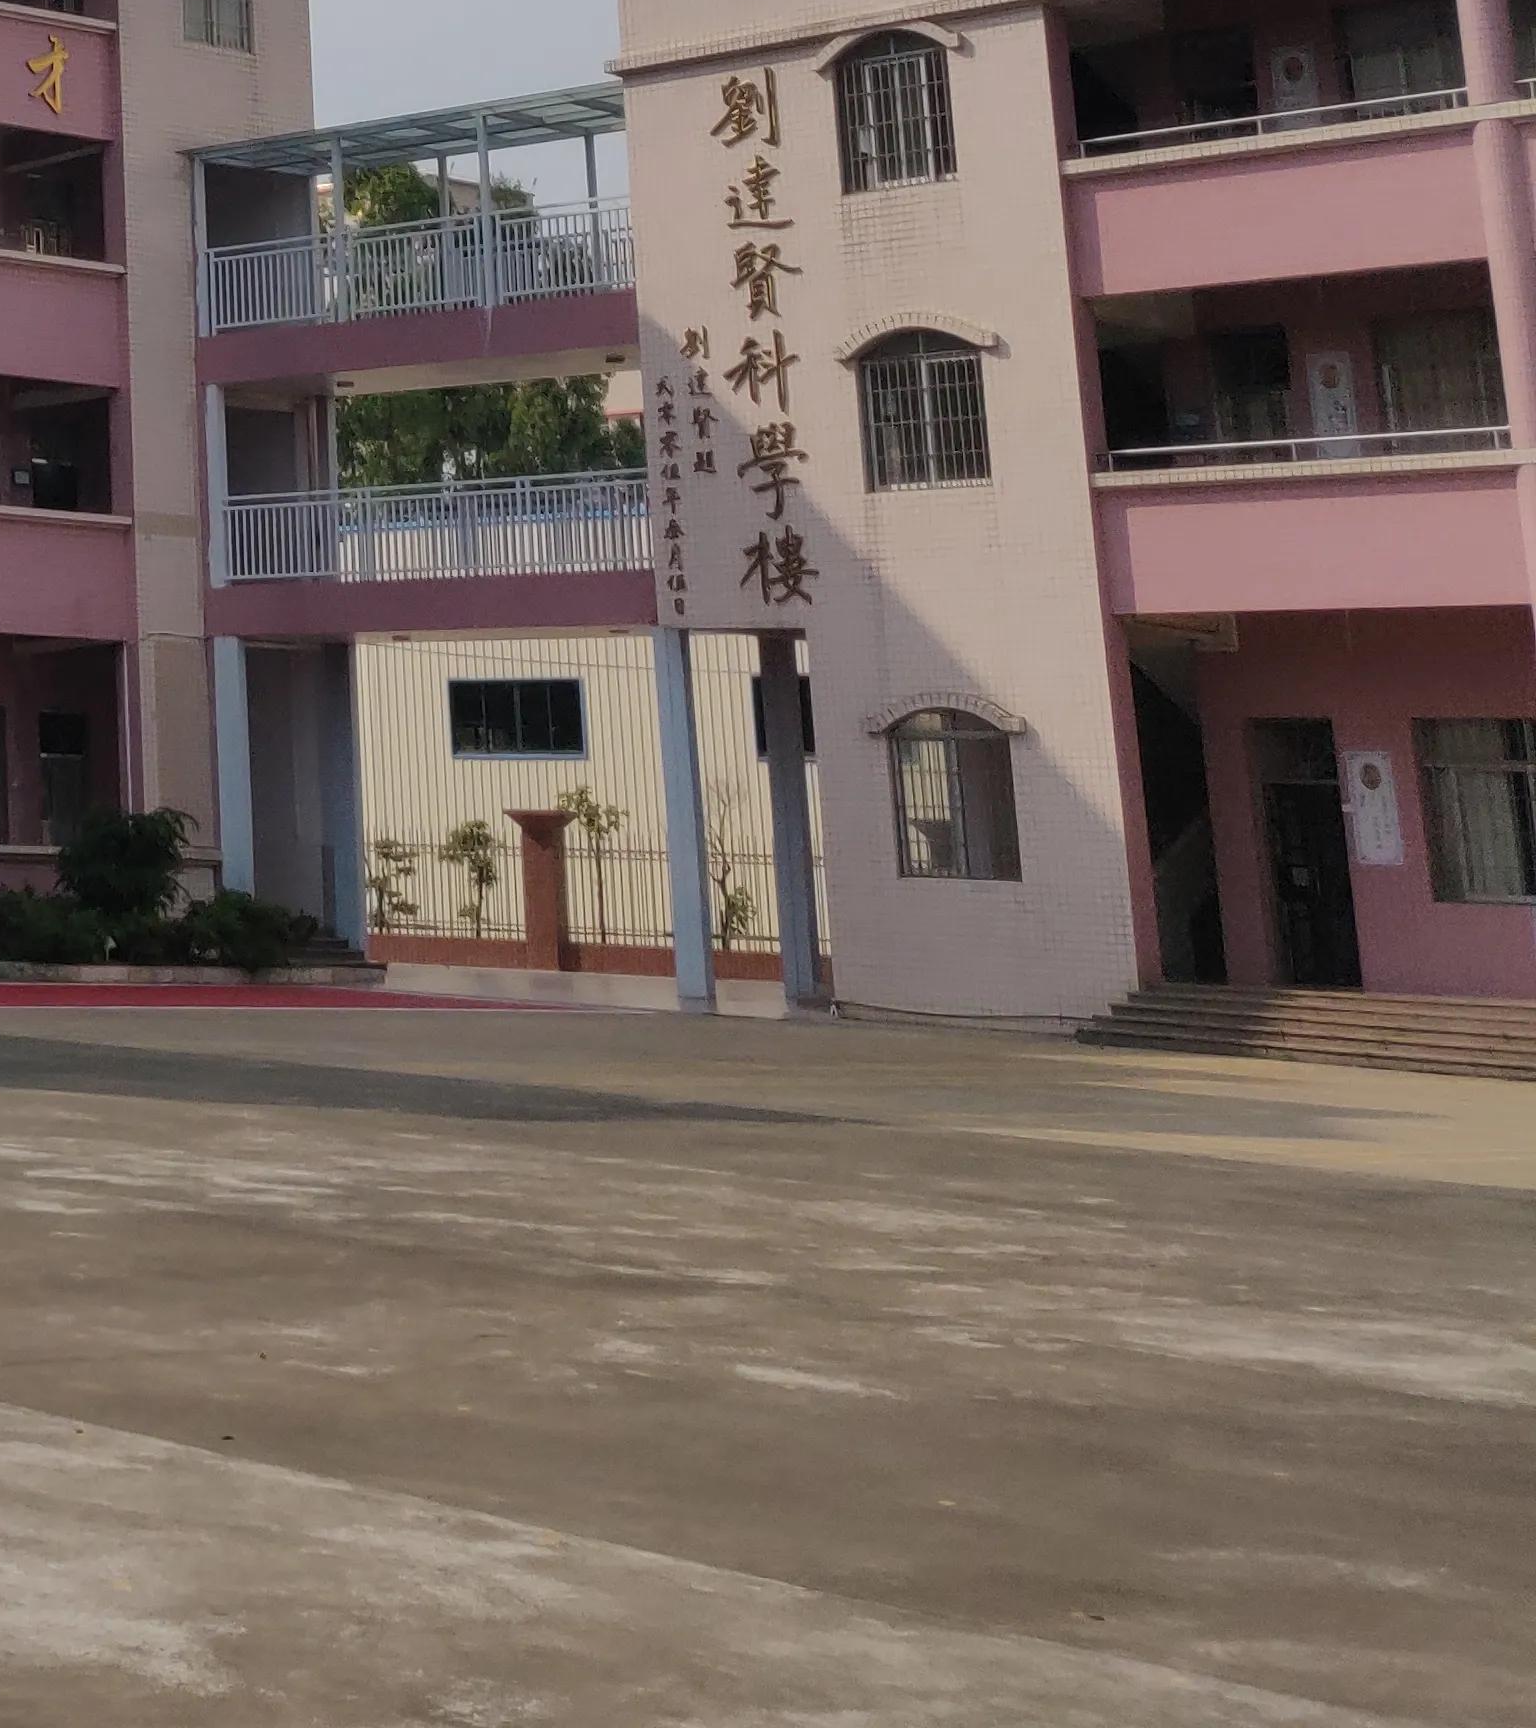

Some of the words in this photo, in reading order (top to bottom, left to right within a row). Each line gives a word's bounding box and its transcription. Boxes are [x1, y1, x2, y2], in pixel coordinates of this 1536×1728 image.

[709, 67, 819, 606] 劉達賢科學樓
